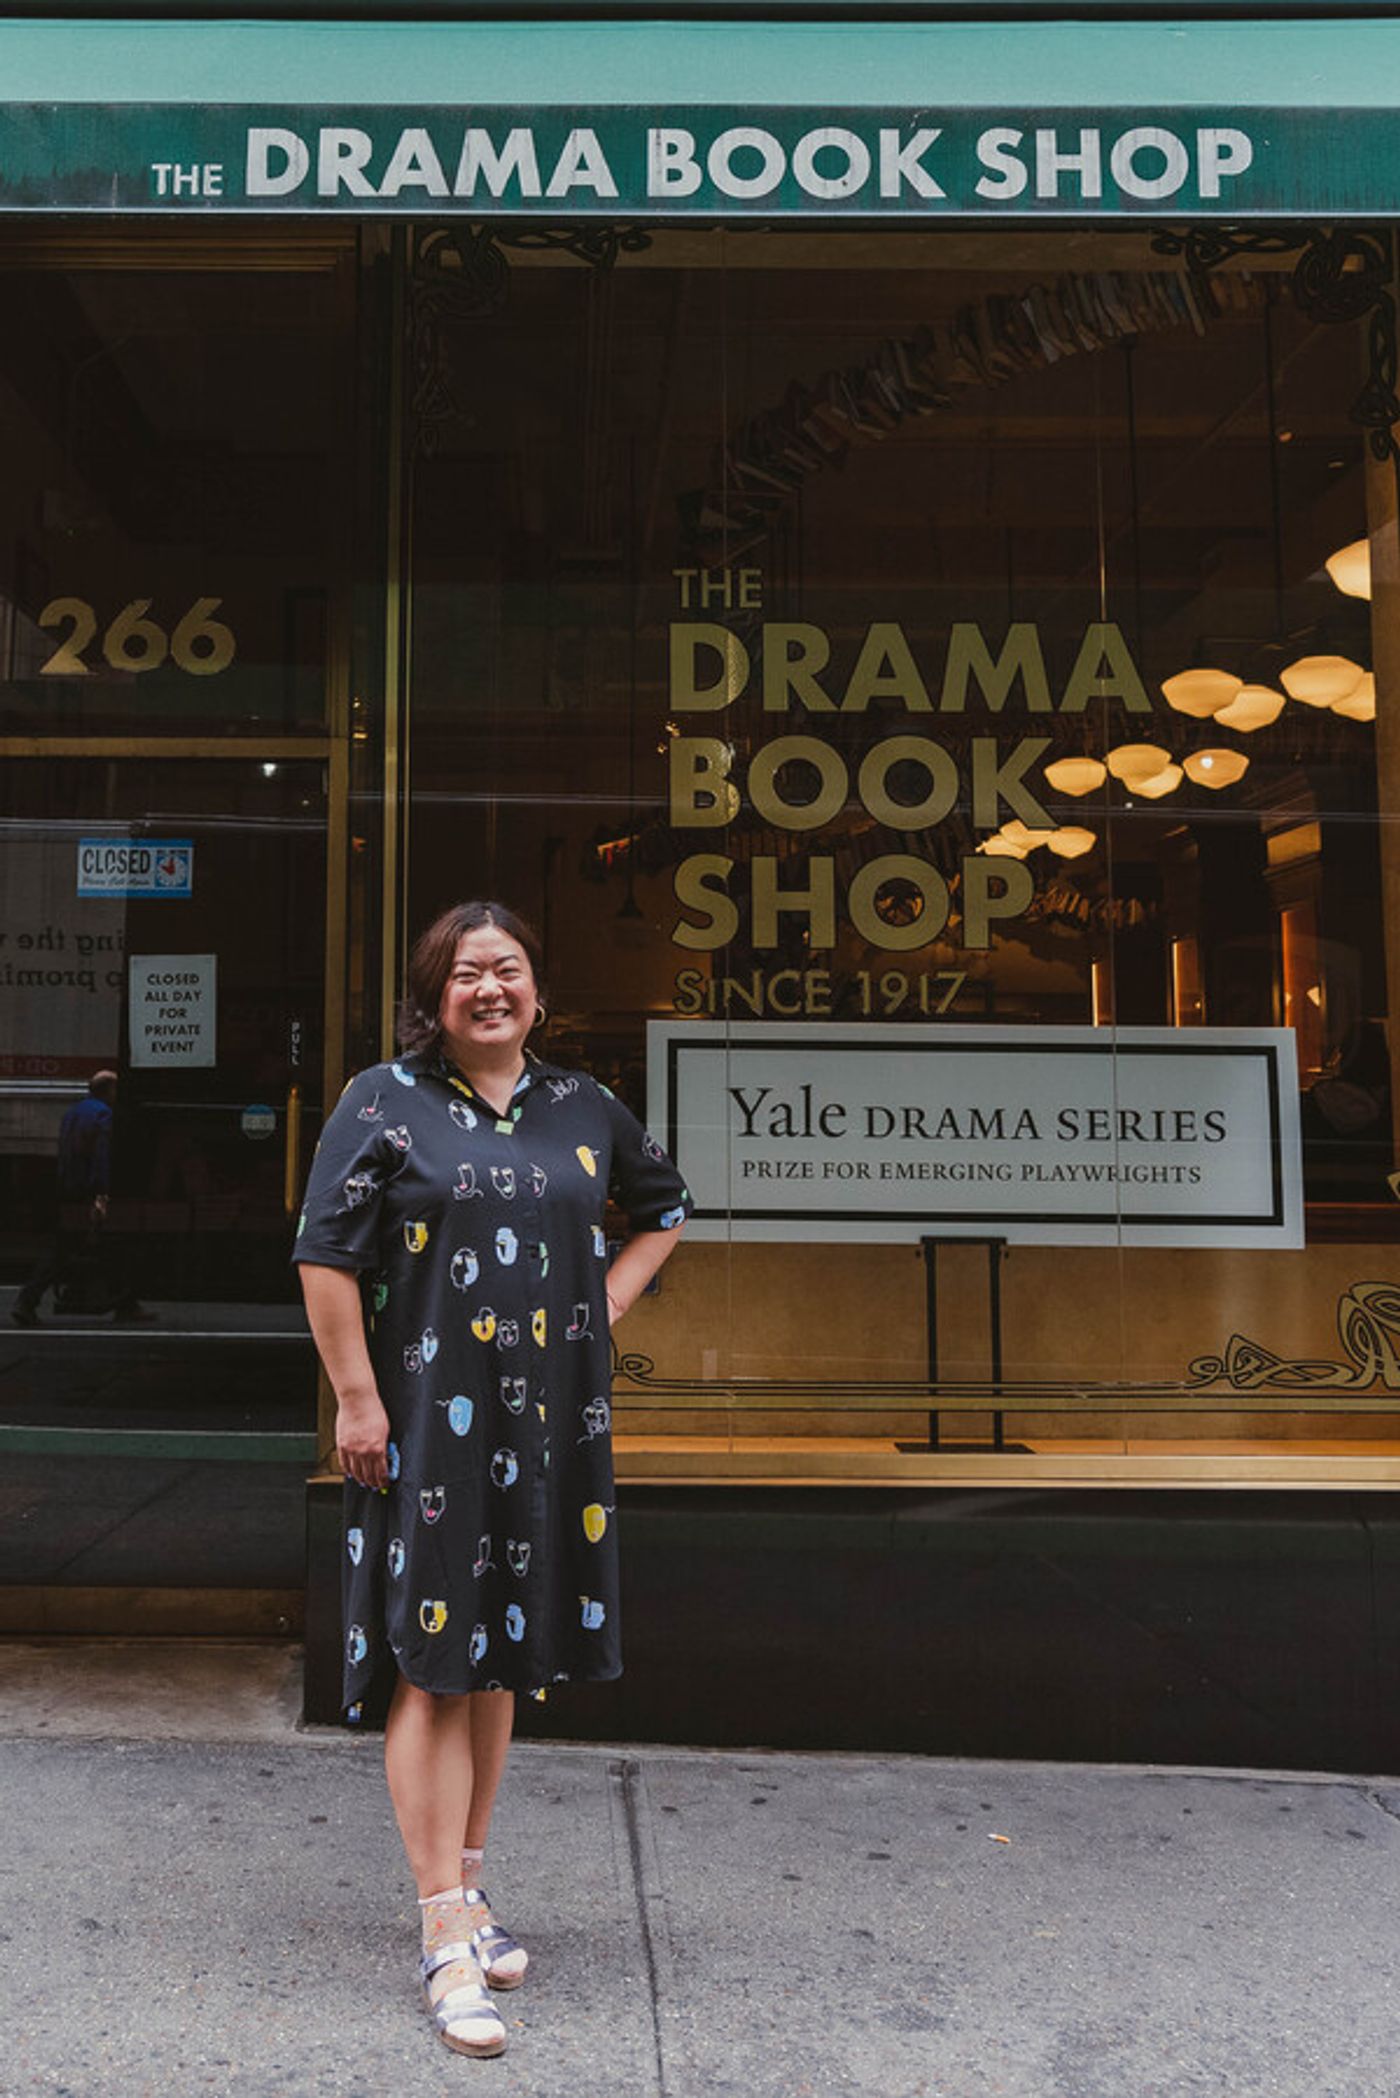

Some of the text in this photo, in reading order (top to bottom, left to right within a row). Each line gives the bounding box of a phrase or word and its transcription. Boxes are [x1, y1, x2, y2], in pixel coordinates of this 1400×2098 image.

[151, 126, 1254, 200] THE DRAMA BOOK SHOP
[672, 568, 763, 609] THE
[38, 596, 237, 677] 266
[668, 622, 1154, 713] DRAMA
[668, 734, 1060, 832] BOOK
[81, 848, 151, 874] CLOSED
[671, 853, 1036, 951] SHOP
[144, 990, 201, 1002] ALL DAY
[146, 973, 200, 986] CLOSED
[673, 968, 969, 1017] SINCE 1917
[144, 1024, 201, 1036] PRIVATE
[158, 1008, 187, 1019] FOR
[151, 1041, 194, 1053] EVENT
[728, 1084, 1228, 1144] Yale DRAMA SERIES
[742, 1159, 1202, 1185] PRIZE FOR EMERGING PLAYWRIGHTS
